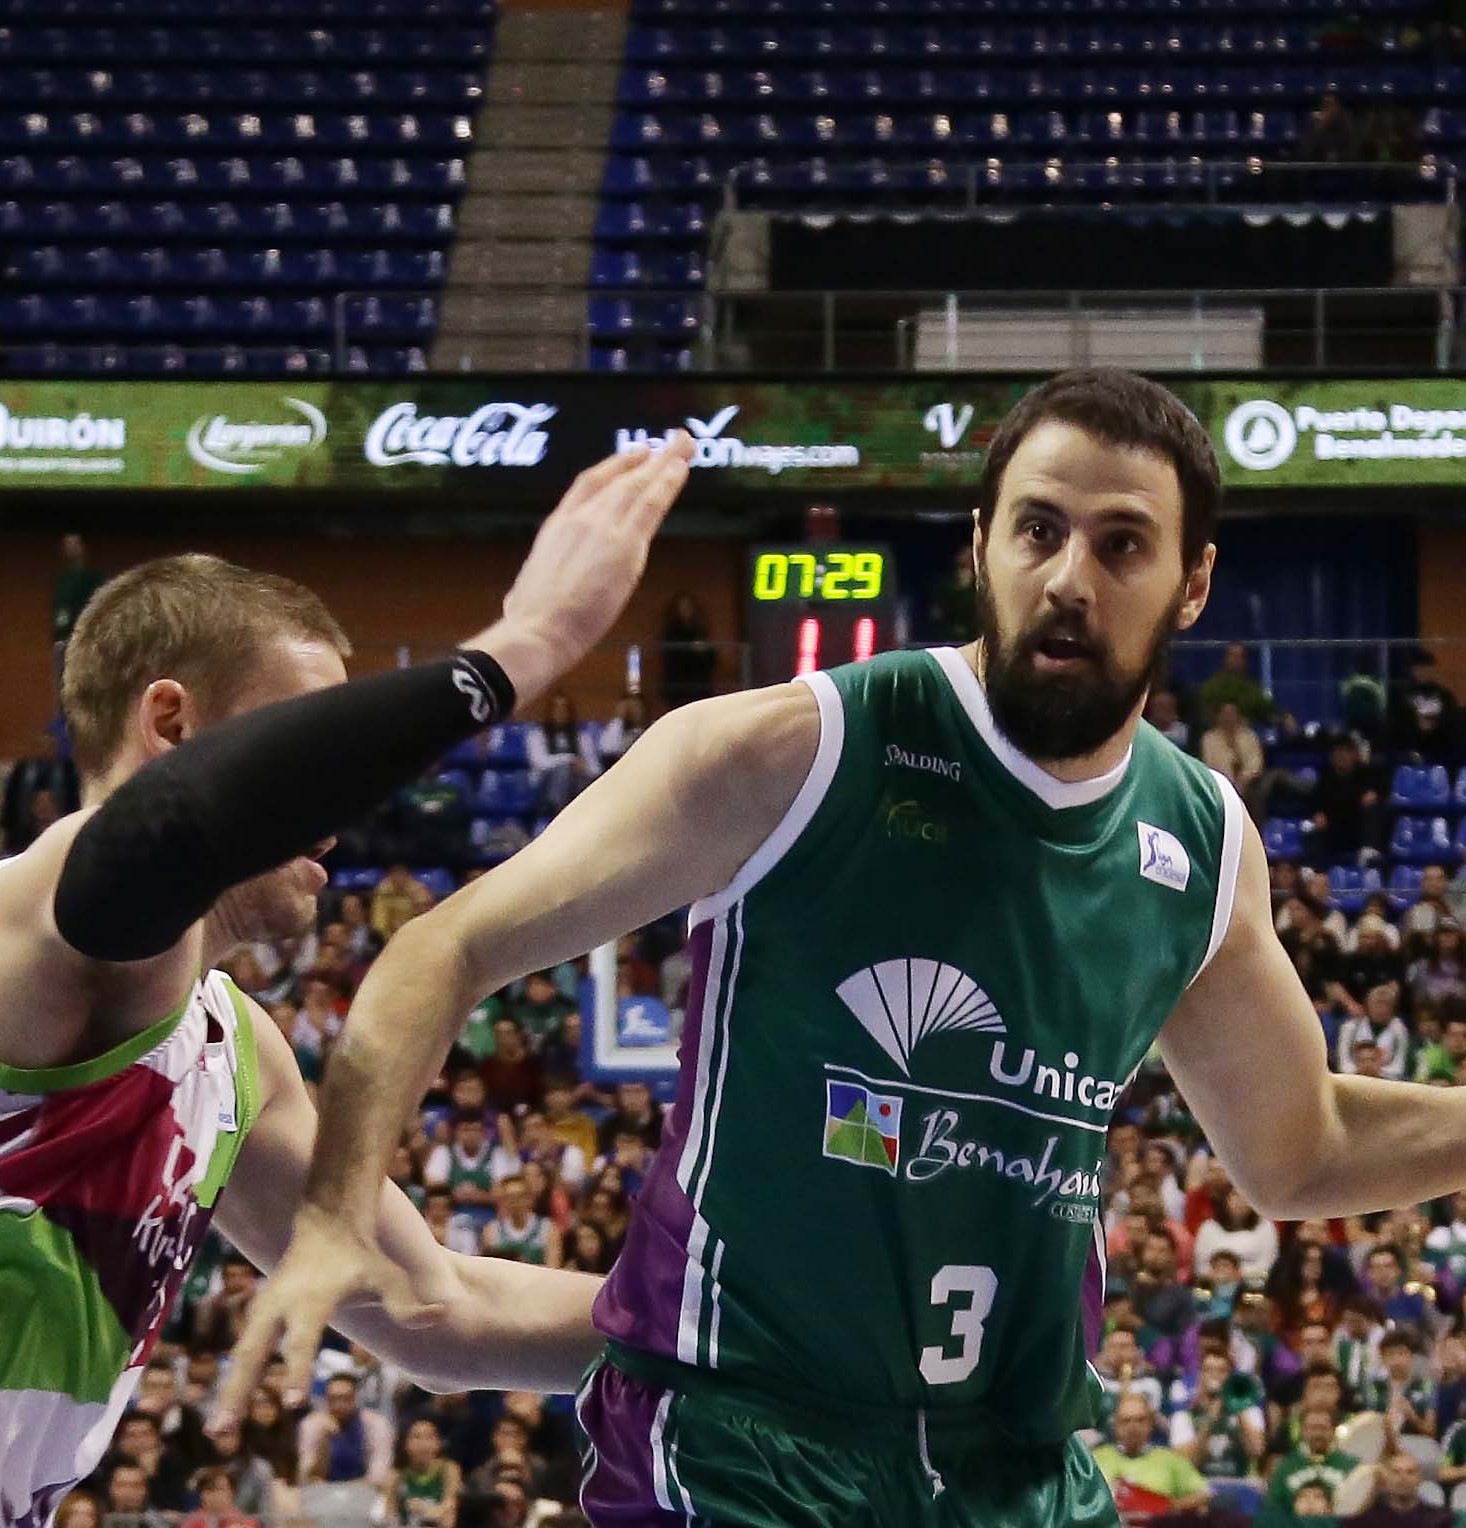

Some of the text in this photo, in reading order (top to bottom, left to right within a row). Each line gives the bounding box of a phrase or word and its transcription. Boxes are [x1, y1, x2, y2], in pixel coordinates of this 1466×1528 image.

[1295, 405, 1387, 432] Puerto
[753, 553, 883, 600] 07:29
[885, 744, 961, 782] SPALDING
[906, 1107, 1101, 1206] Benahaví
[919, 1265, 999, 1385] 3
